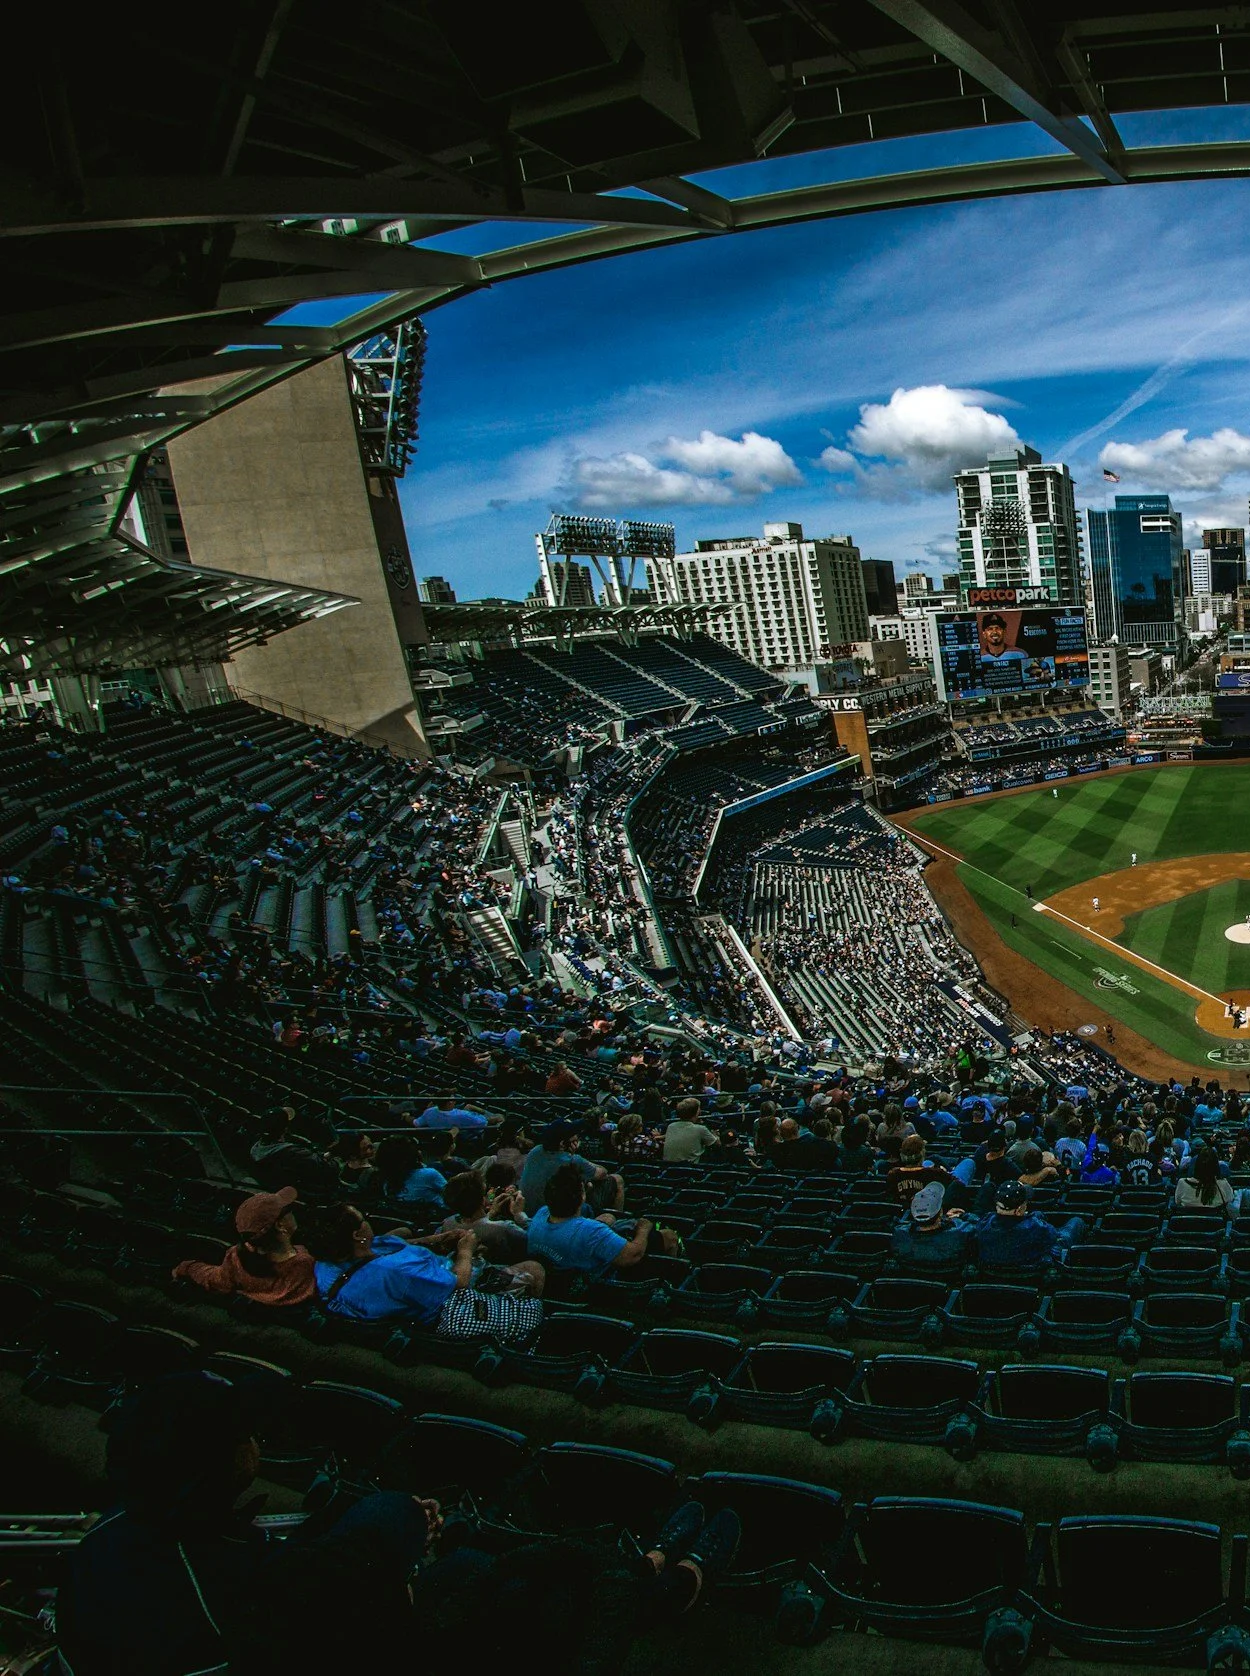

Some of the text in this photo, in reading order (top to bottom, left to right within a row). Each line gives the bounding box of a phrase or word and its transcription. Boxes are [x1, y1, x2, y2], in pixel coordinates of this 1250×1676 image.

[1024, 626, 1028, 636] 5
[832, 644, 858, 655] TOYOTA
[862, 692, 888, 705] WESTERN
[888, 686, 904, 699] METAL
[906, 683, 923, 694] SUPPLY
[844, 698, 861, 710] CO.
[1136, 755, 1153, 763] ARCO
[1170, 752, 1190, 760] Sycuan
[1044, 771, 1068, 780] GEICO
[1003, 779, 1033, 788] Qualcomm
[952, 984, 974, 1002] WELCOME
[1126, 1159, 1153, 1171] MACHADO
[1132, 1169, 1149, 1185] 13
[897, 1180, 924, 1192] GWYNN
